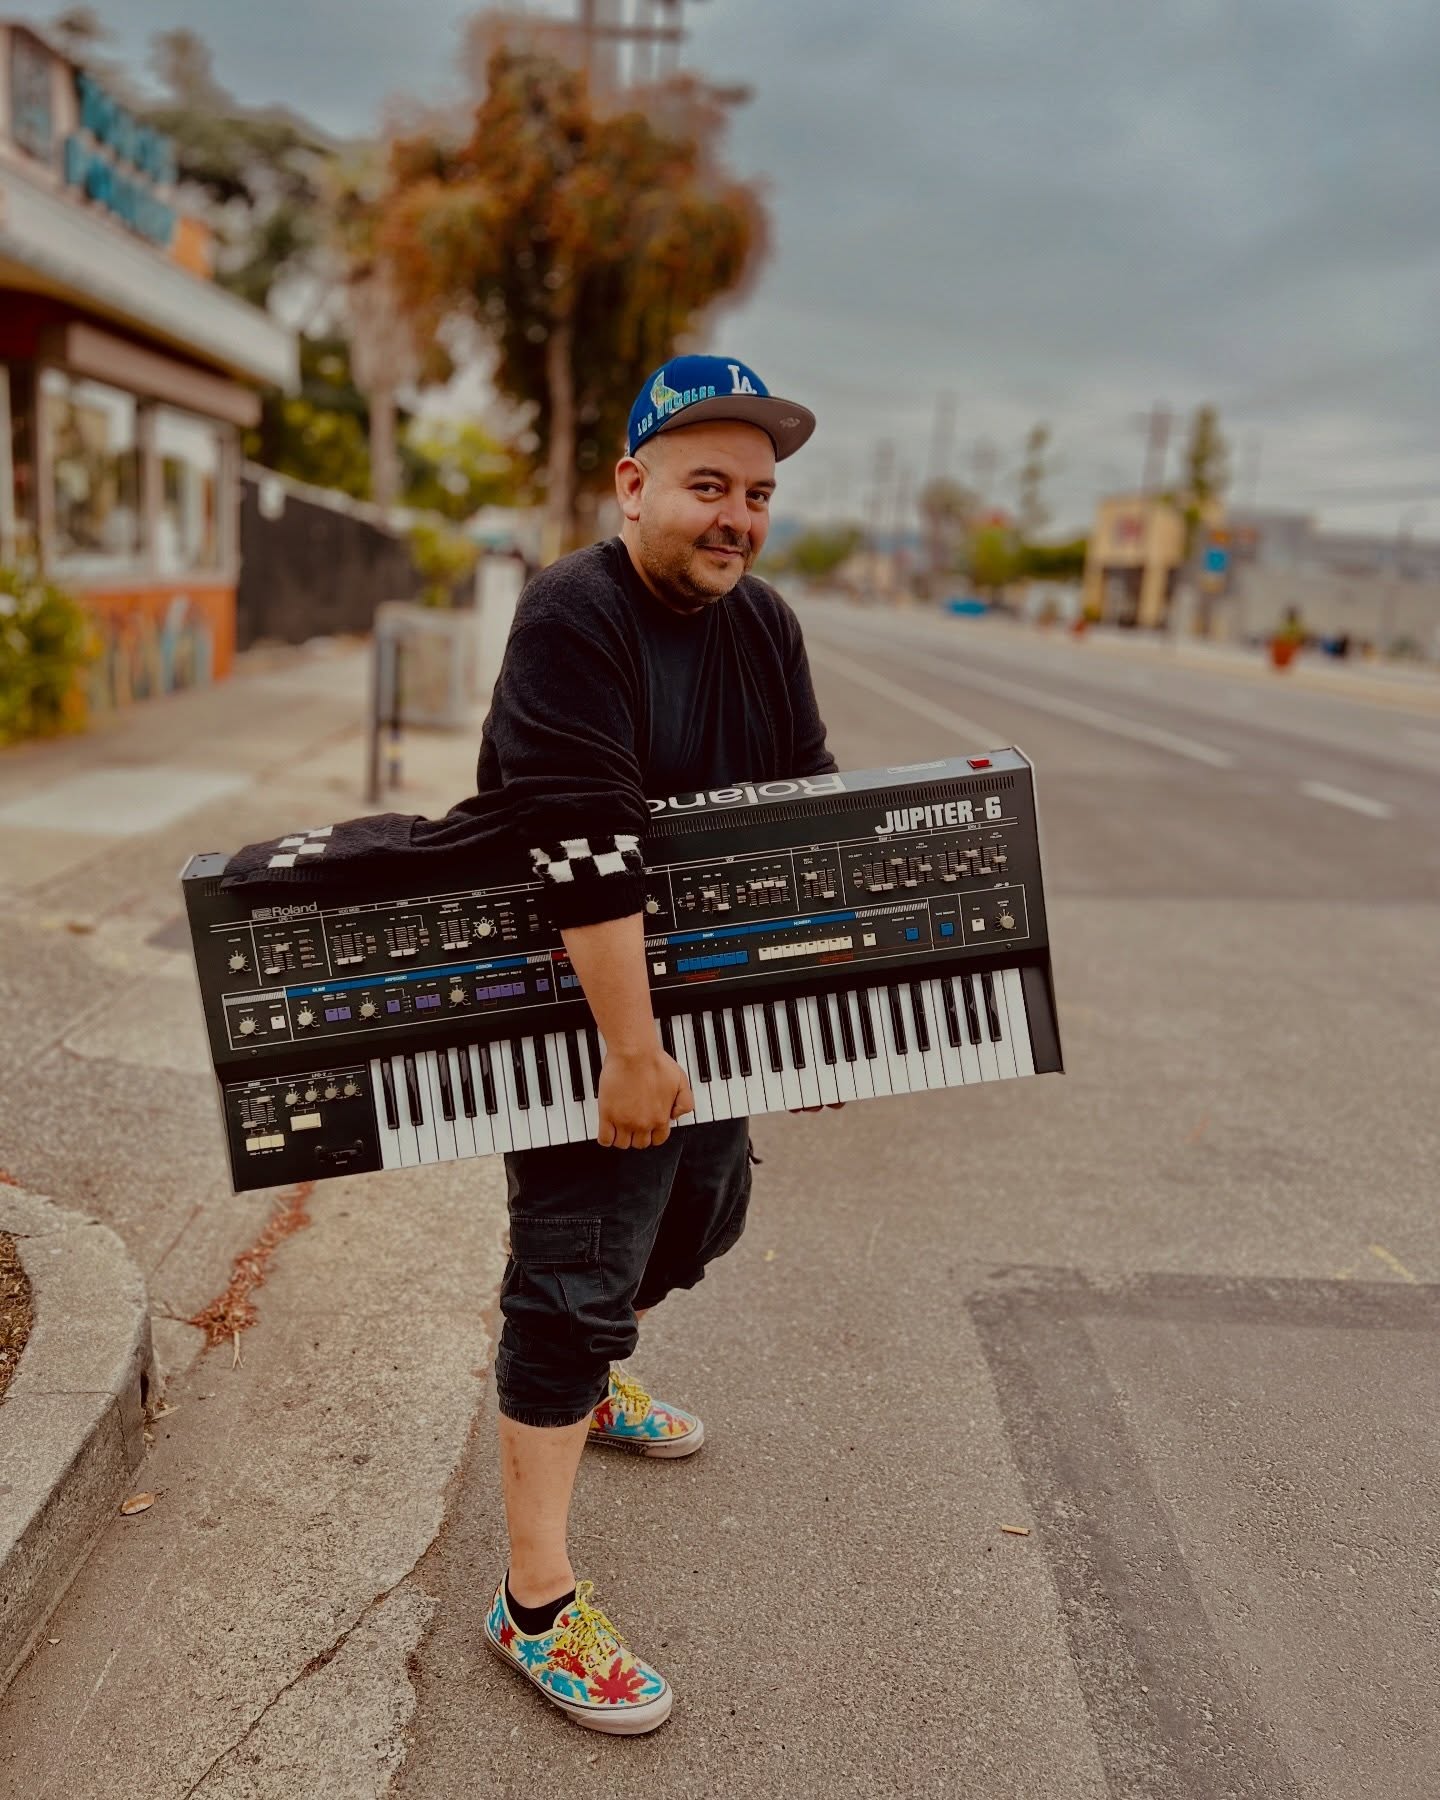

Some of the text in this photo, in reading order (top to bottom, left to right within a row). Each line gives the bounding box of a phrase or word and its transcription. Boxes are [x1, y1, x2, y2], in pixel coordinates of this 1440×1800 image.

[727, 364, 757, 394] LA
[637, 385, 716, 436] LOS ANGELES
[874, 796, 1002, 835] JUPITER-6
[271, 901, 318, 917] Roland
